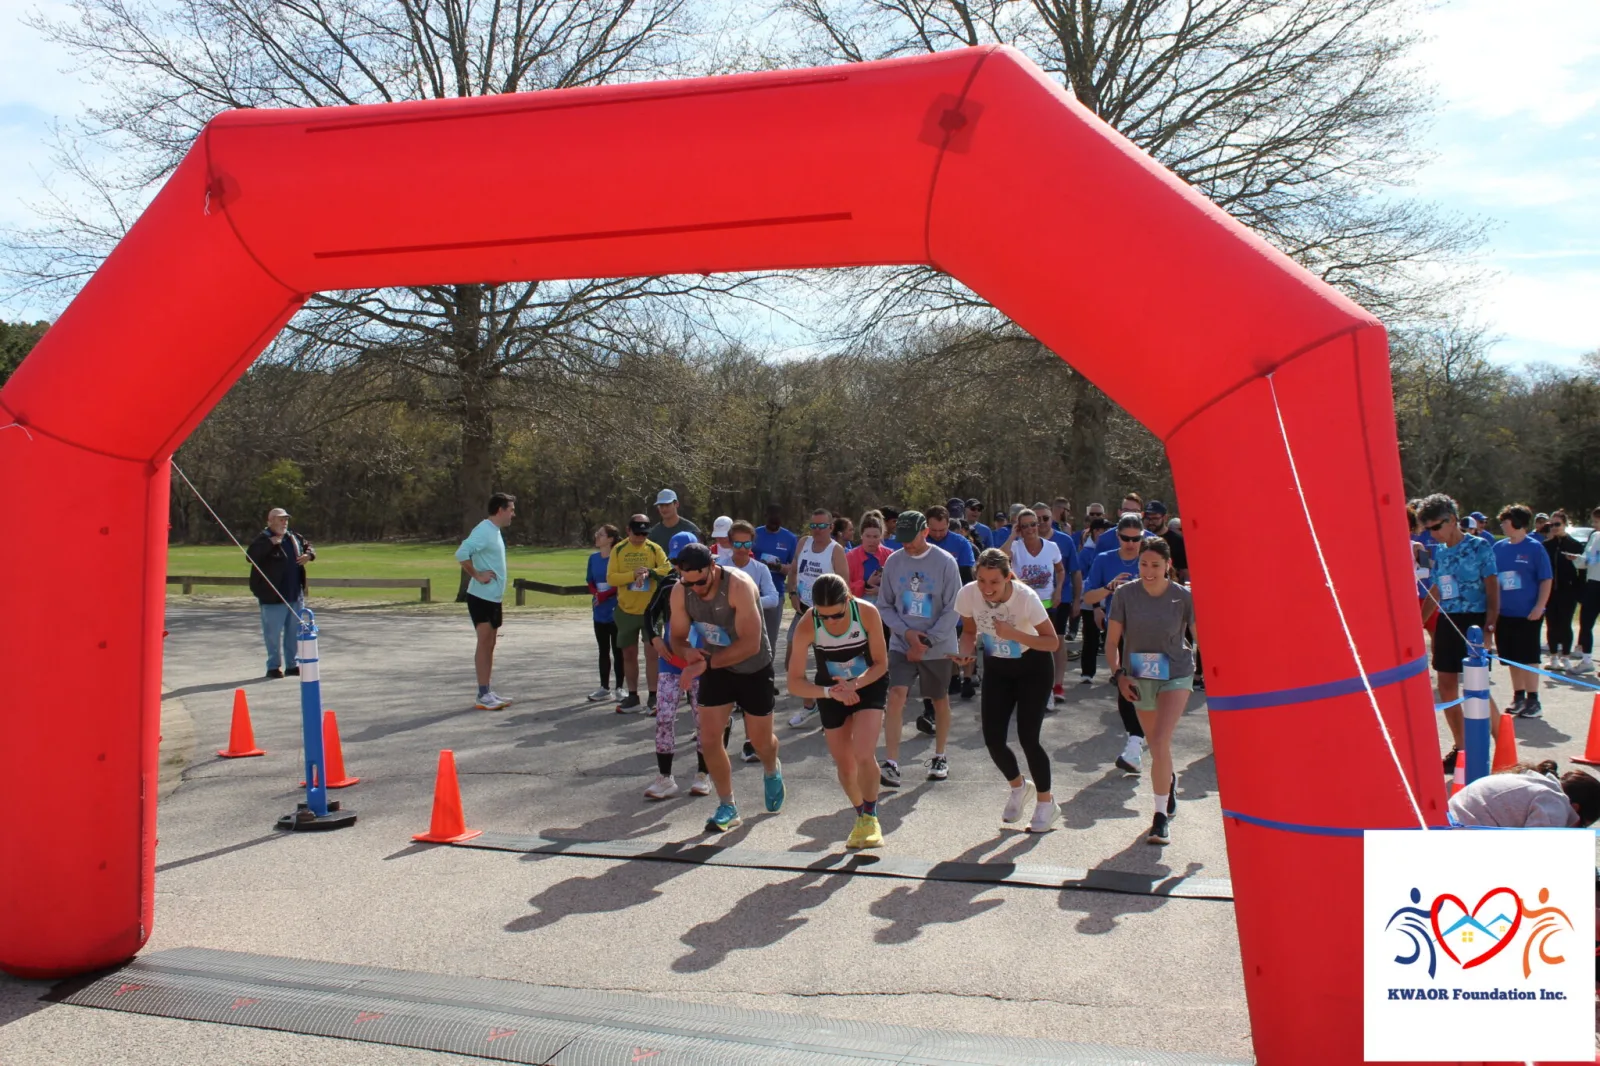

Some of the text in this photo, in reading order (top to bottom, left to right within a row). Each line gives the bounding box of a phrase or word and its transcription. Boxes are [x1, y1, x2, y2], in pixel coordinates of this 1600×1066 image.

[910, 600, 923, 614] 51
[704, 630, 720, 643] 27
[994, 643, 1011, 656] 19
[1142, 661, 1160, 676] 24
